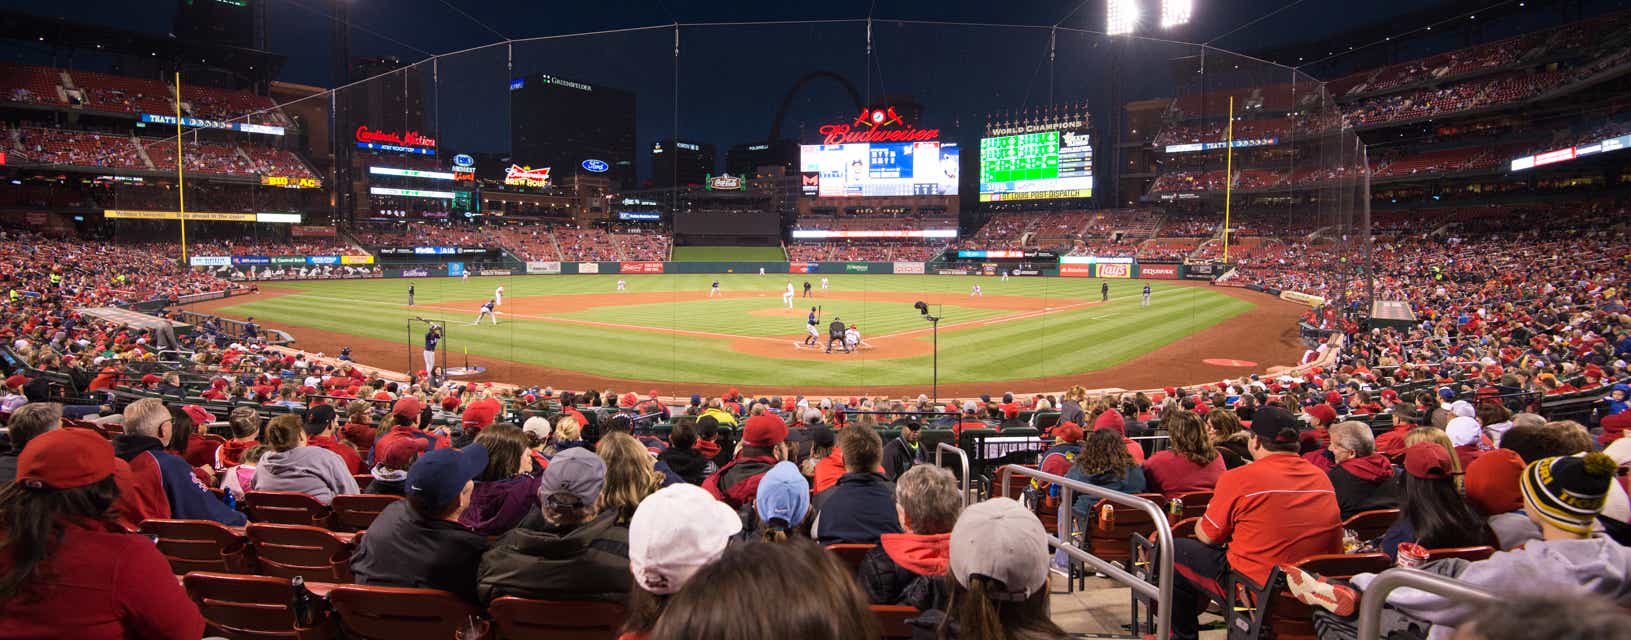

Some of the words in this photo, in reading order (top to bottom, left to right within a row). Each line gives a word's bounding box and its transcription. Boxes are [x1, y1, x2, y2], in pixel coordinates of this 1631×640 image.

[819, 124, 940, 145] Budweiser
[992, 124, 1025, 136] WORLD
[1026, 121, 1082, 133] CHAMPIONS
[587, 160, 604, 170] Ford
[269, 177, 288, 185] BIG
